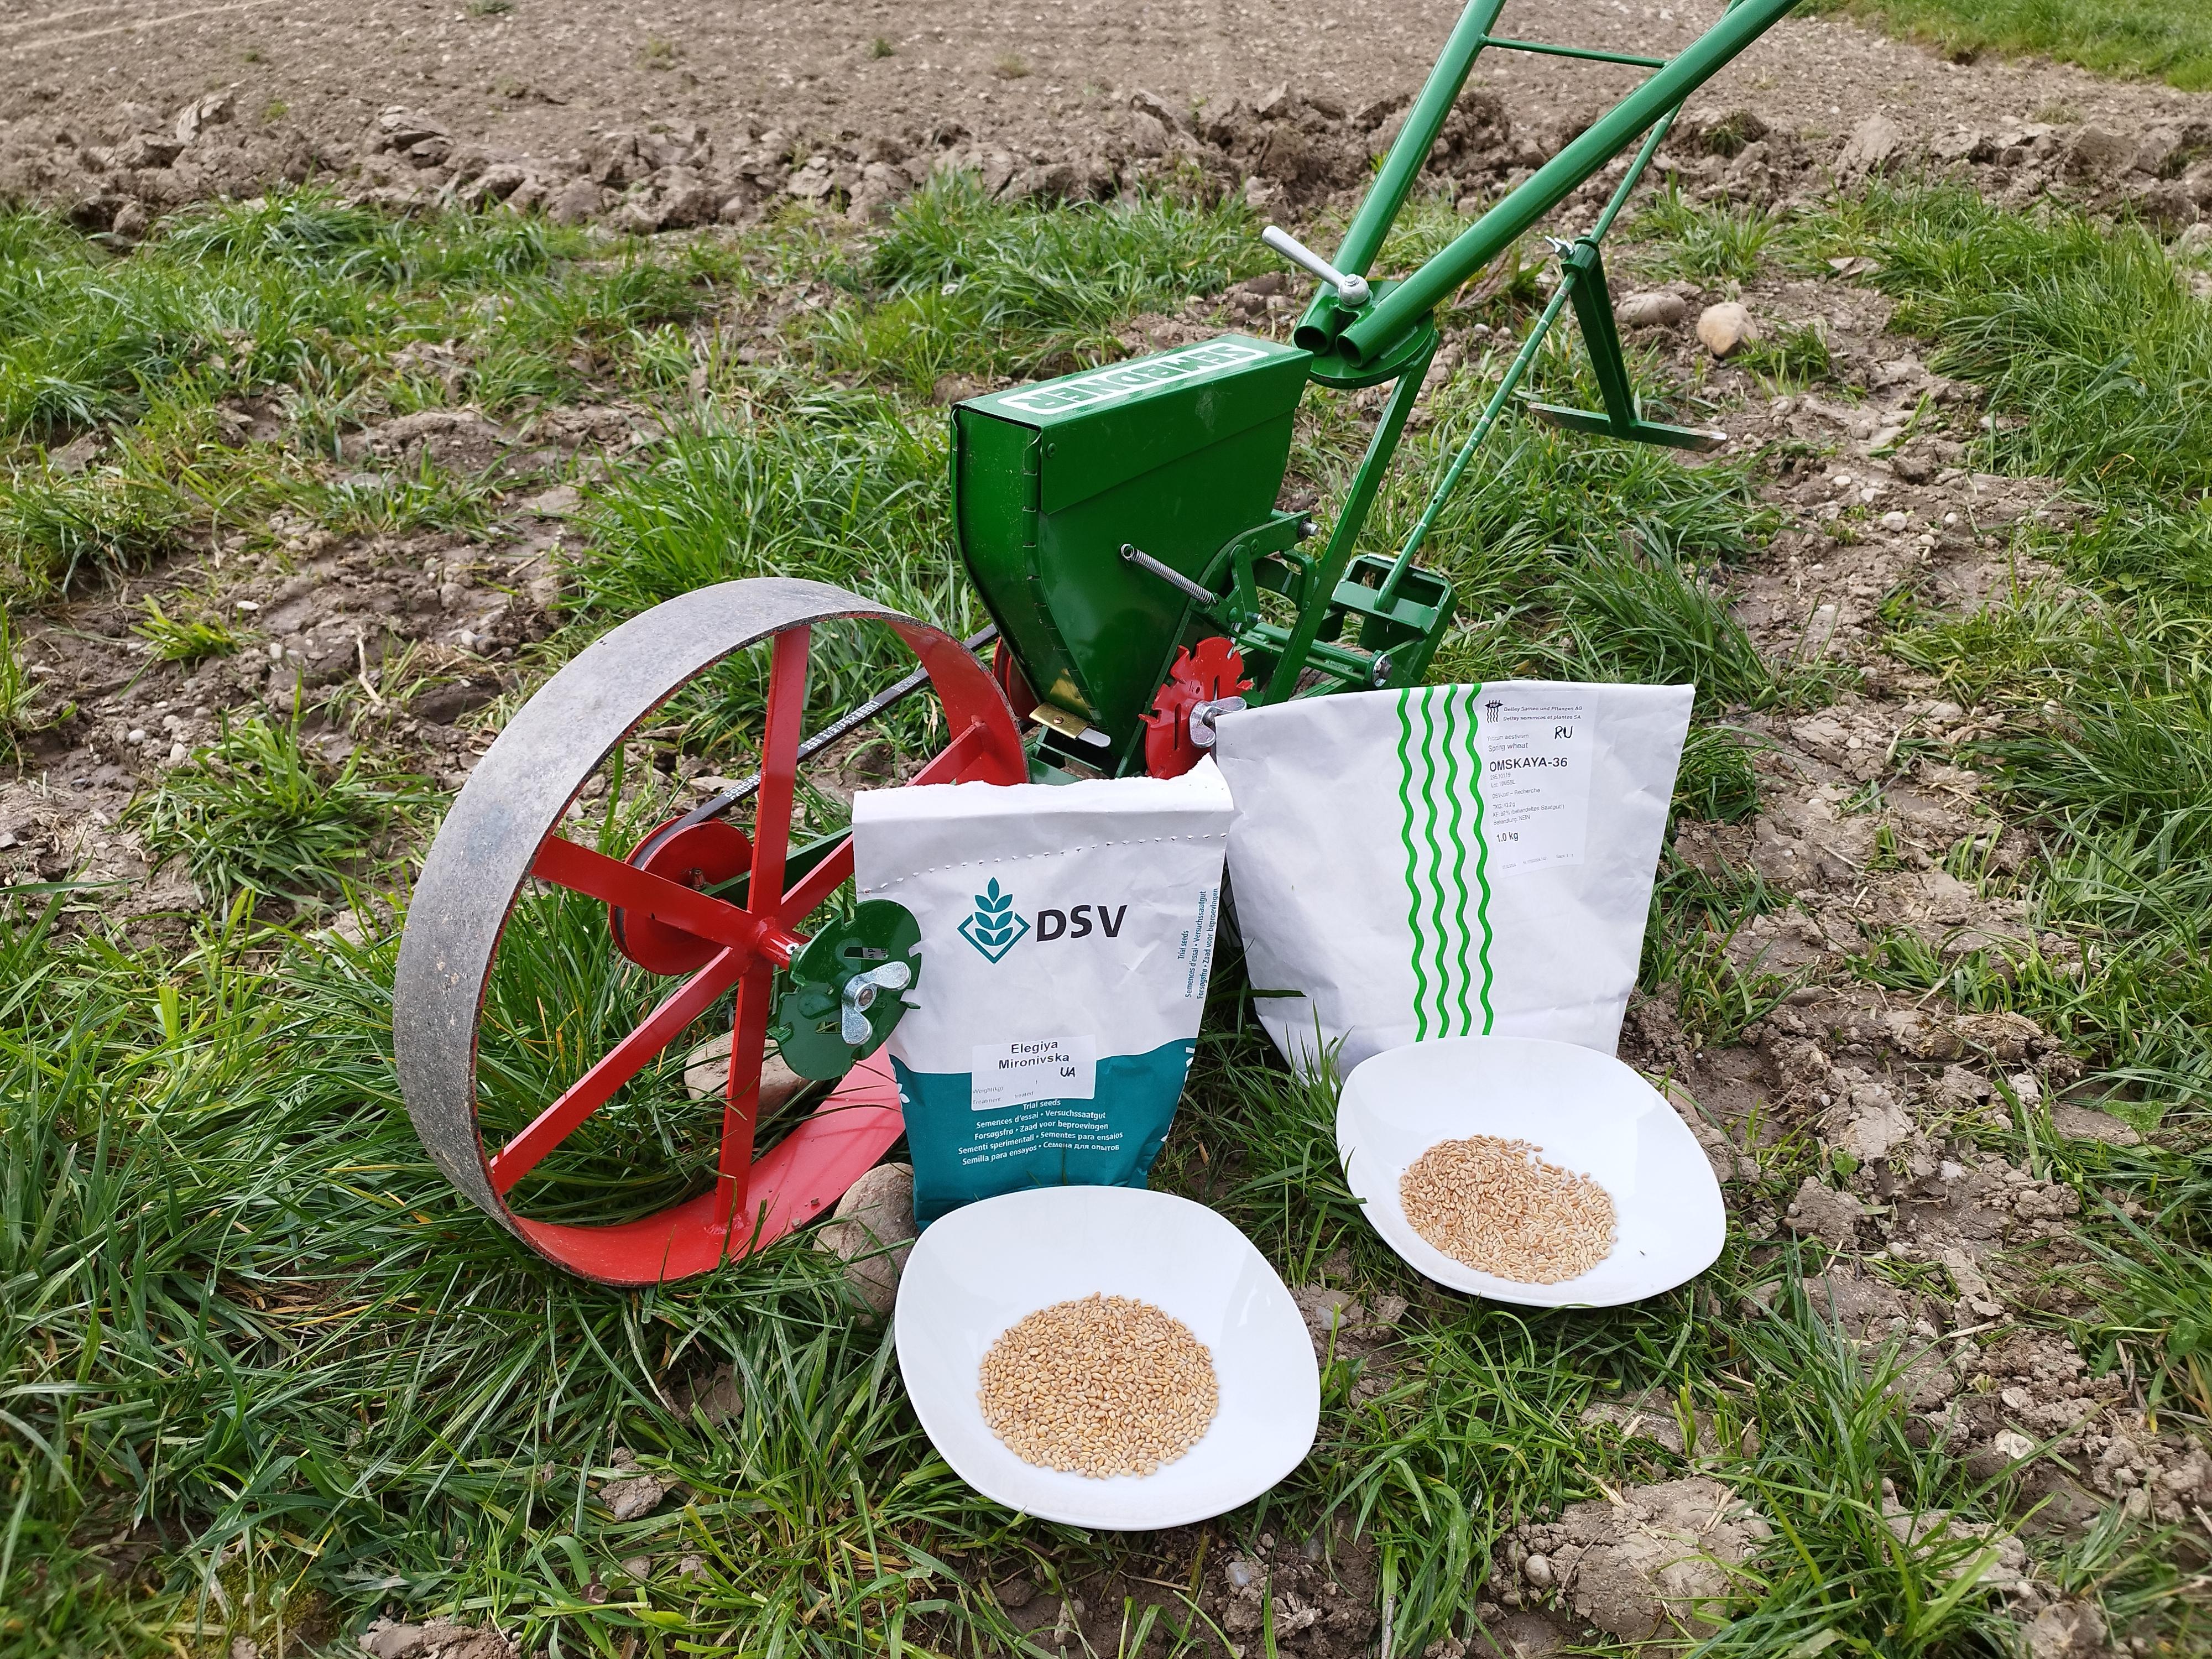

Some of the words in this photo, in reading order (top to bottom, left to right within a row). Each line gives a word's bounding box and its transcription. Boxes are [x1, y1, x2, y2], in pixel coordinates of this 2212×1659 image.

[1010, 346, 1256, 409] SEMBDNER
[1554, 726, 1573, 739] RU
[1488, 744, 1505, 753] Spring
[1489, 757, 1568, 772] OMSKAYA-36
[1496, 833, 1507, 842] 1.0
[1509, 831, 1519, 841] kg
[1207, 888, 1218, 932] beproevingen
[1036, 905, 1128, 942] DSV
[1177, 947, 1186, 959] Trial
[1185, 968, 1195, 998] Semences
[1193, 891, 1207, 942] Versuchssaatgut
[1202, 950, 1211, 964] Zaad
[1197, 968, 1208, 999] Forsøgsfrø
[1011, 1041, 1058, 1054] Elegiya
[999, 1053, 1070, 1070] Mironivska
[1060, 1067, 1076, 1077] UA
[1023, 1100, 1038, 1111] Trial
[976, 1118, 1013, 1129] Semences
[1045, 1109, 1106, 1120] Versuchssaatgut
[974, 1128, 1013, 1140] Forsøgsfrø
[1020, 1123, 1037, 1133] Zaad
[1057, 1120, 1108, 1131] beproevingen
[958, 1143, 988, 1155] Sementi
[989, 1134, 1034, 1151] sperimentali
[1097, 1132, 1123, 1141] ensaios
[962, 1155, 989, 1165] Semilla
[991, 1152, 1008, 1162] para
[1009, 1145, 1037, 1156] ensayos
